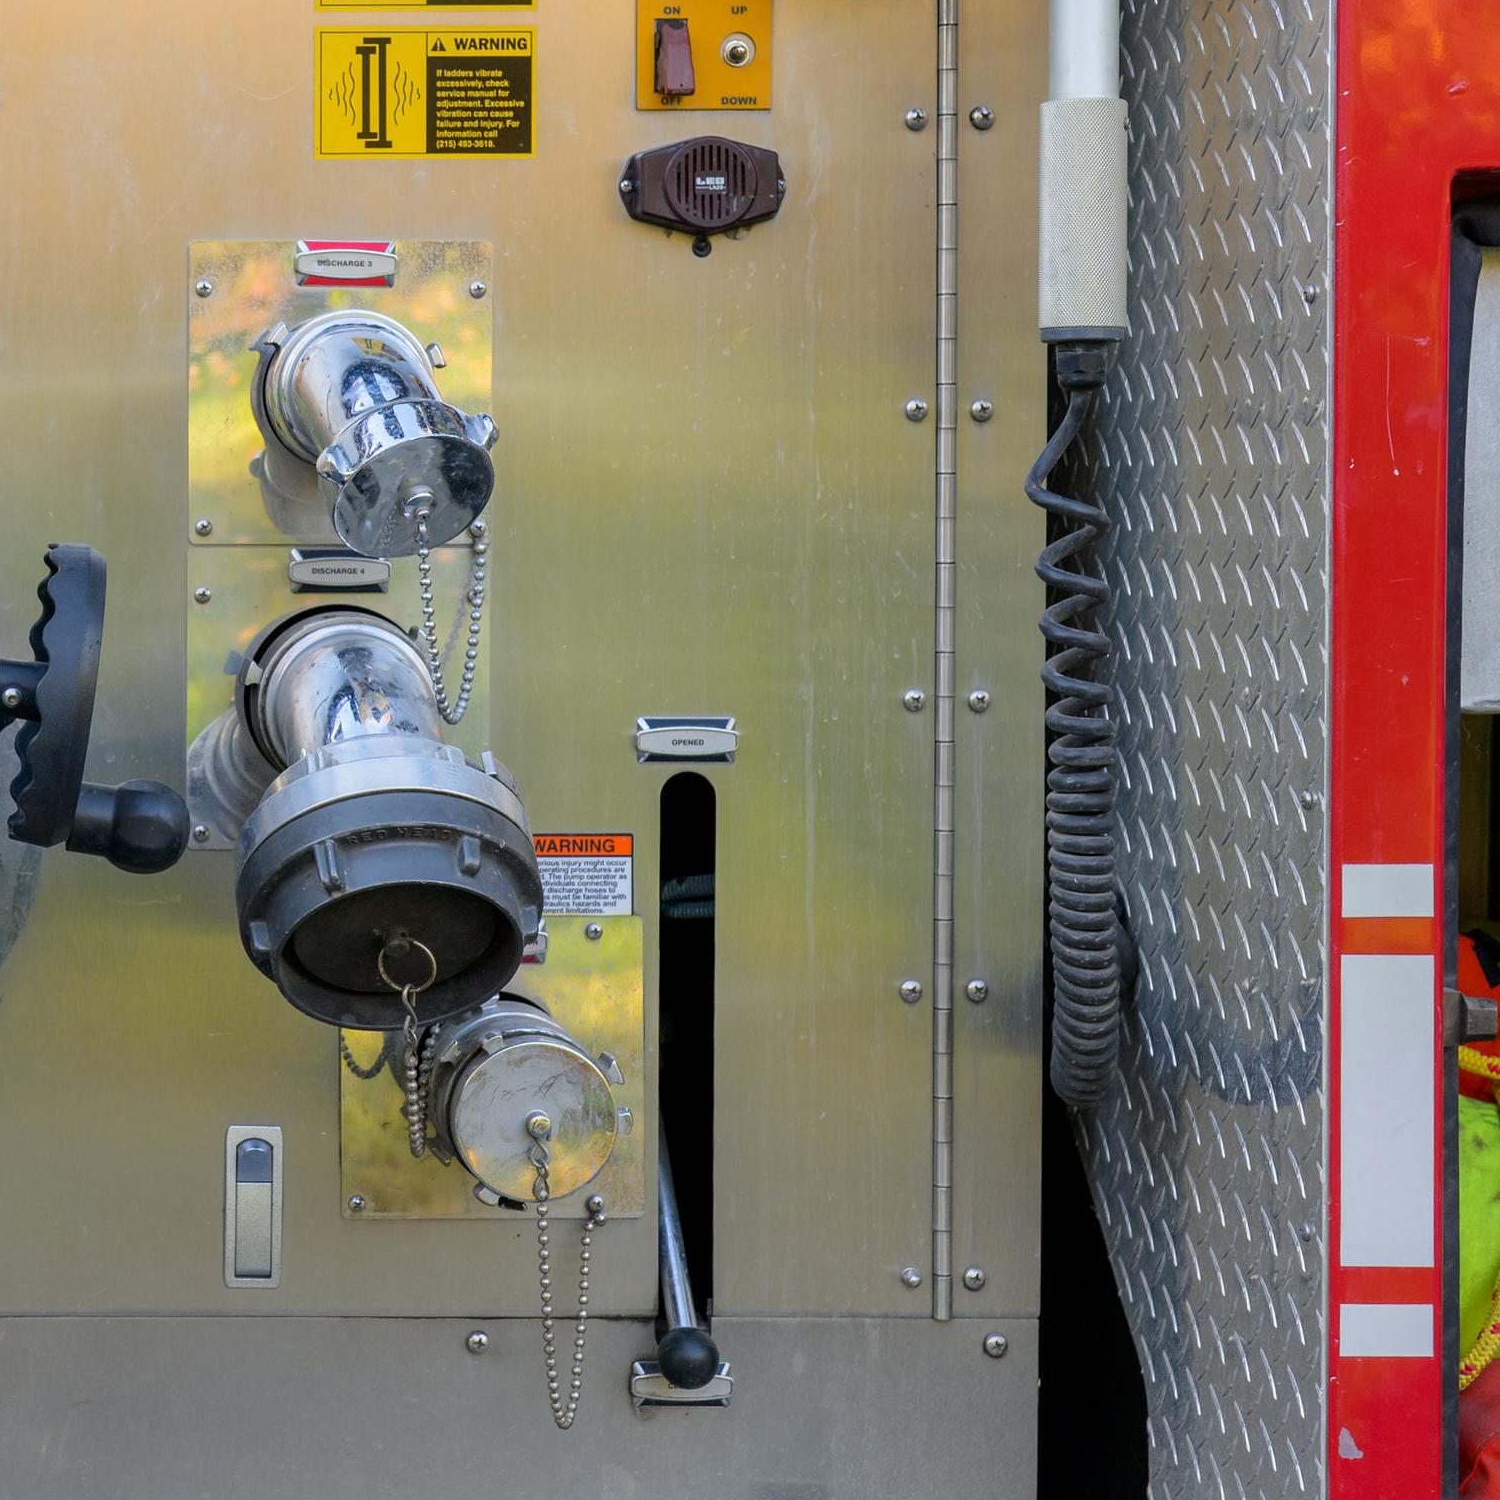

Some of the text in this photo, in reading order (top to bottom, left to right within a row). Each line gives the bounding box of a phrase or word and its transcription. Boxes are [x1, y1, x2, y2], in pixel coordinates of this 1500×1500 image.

[663, 6, 747, 15] ON UP
[454, 38, 527, 50] WARNING
[436, 69, 502, 77] If ladders vibrate
[436, 79, 509, 88] excessively, check
[467, 89, 496, 97] manual
[498, 89, 510, 97] for
[436, 99, 525, 109] adjustment. Excessive
[661, 97, 756, 105] OFF DOWN
[480, 120, 504, 129] injury.
[436, 140, 456, 148] (215)
[317, 259, 365, 267] DISCHARGE
[347, 827, 450, 845] RED HEAD
[535, 839, 615, 853] WARNING
